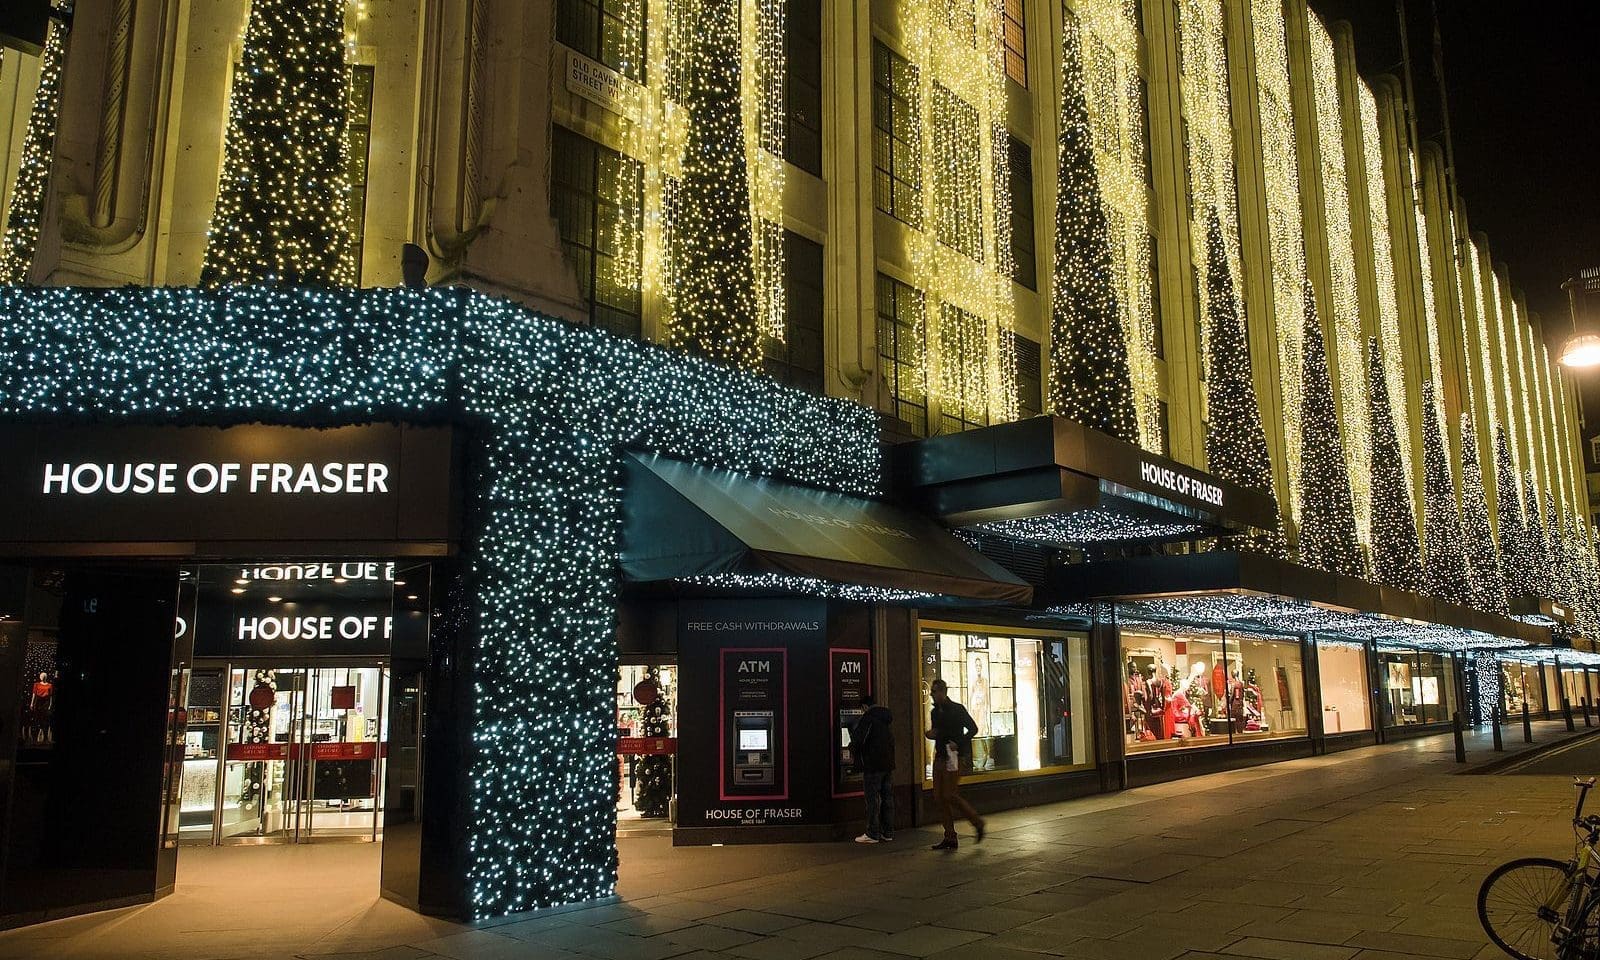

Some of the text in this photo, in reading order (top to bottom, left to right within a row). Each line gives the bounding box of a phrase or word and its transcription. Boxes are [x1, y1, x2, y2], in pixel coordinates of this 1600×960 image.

[572, 58, 589, 74] OLD
[572, 69, 603, 92] STREET
[43, 463, 388, 494] HOUSE OF FRASER
[1141, 461, 1223, 507] HOUSE OF FRASER
[239, 616, 333, 640] HOUSE
[339, 616, 378, 640] OF
[687, 621, 819, 631] FREE CASH WITHDRAWALS
[967, 635, 987, 649] Dior
[738, 660, 770, 673] ATM
[840, 661, 861, 673] ATM
[705, 808, 802, 819] HOUSE OF FRASER
